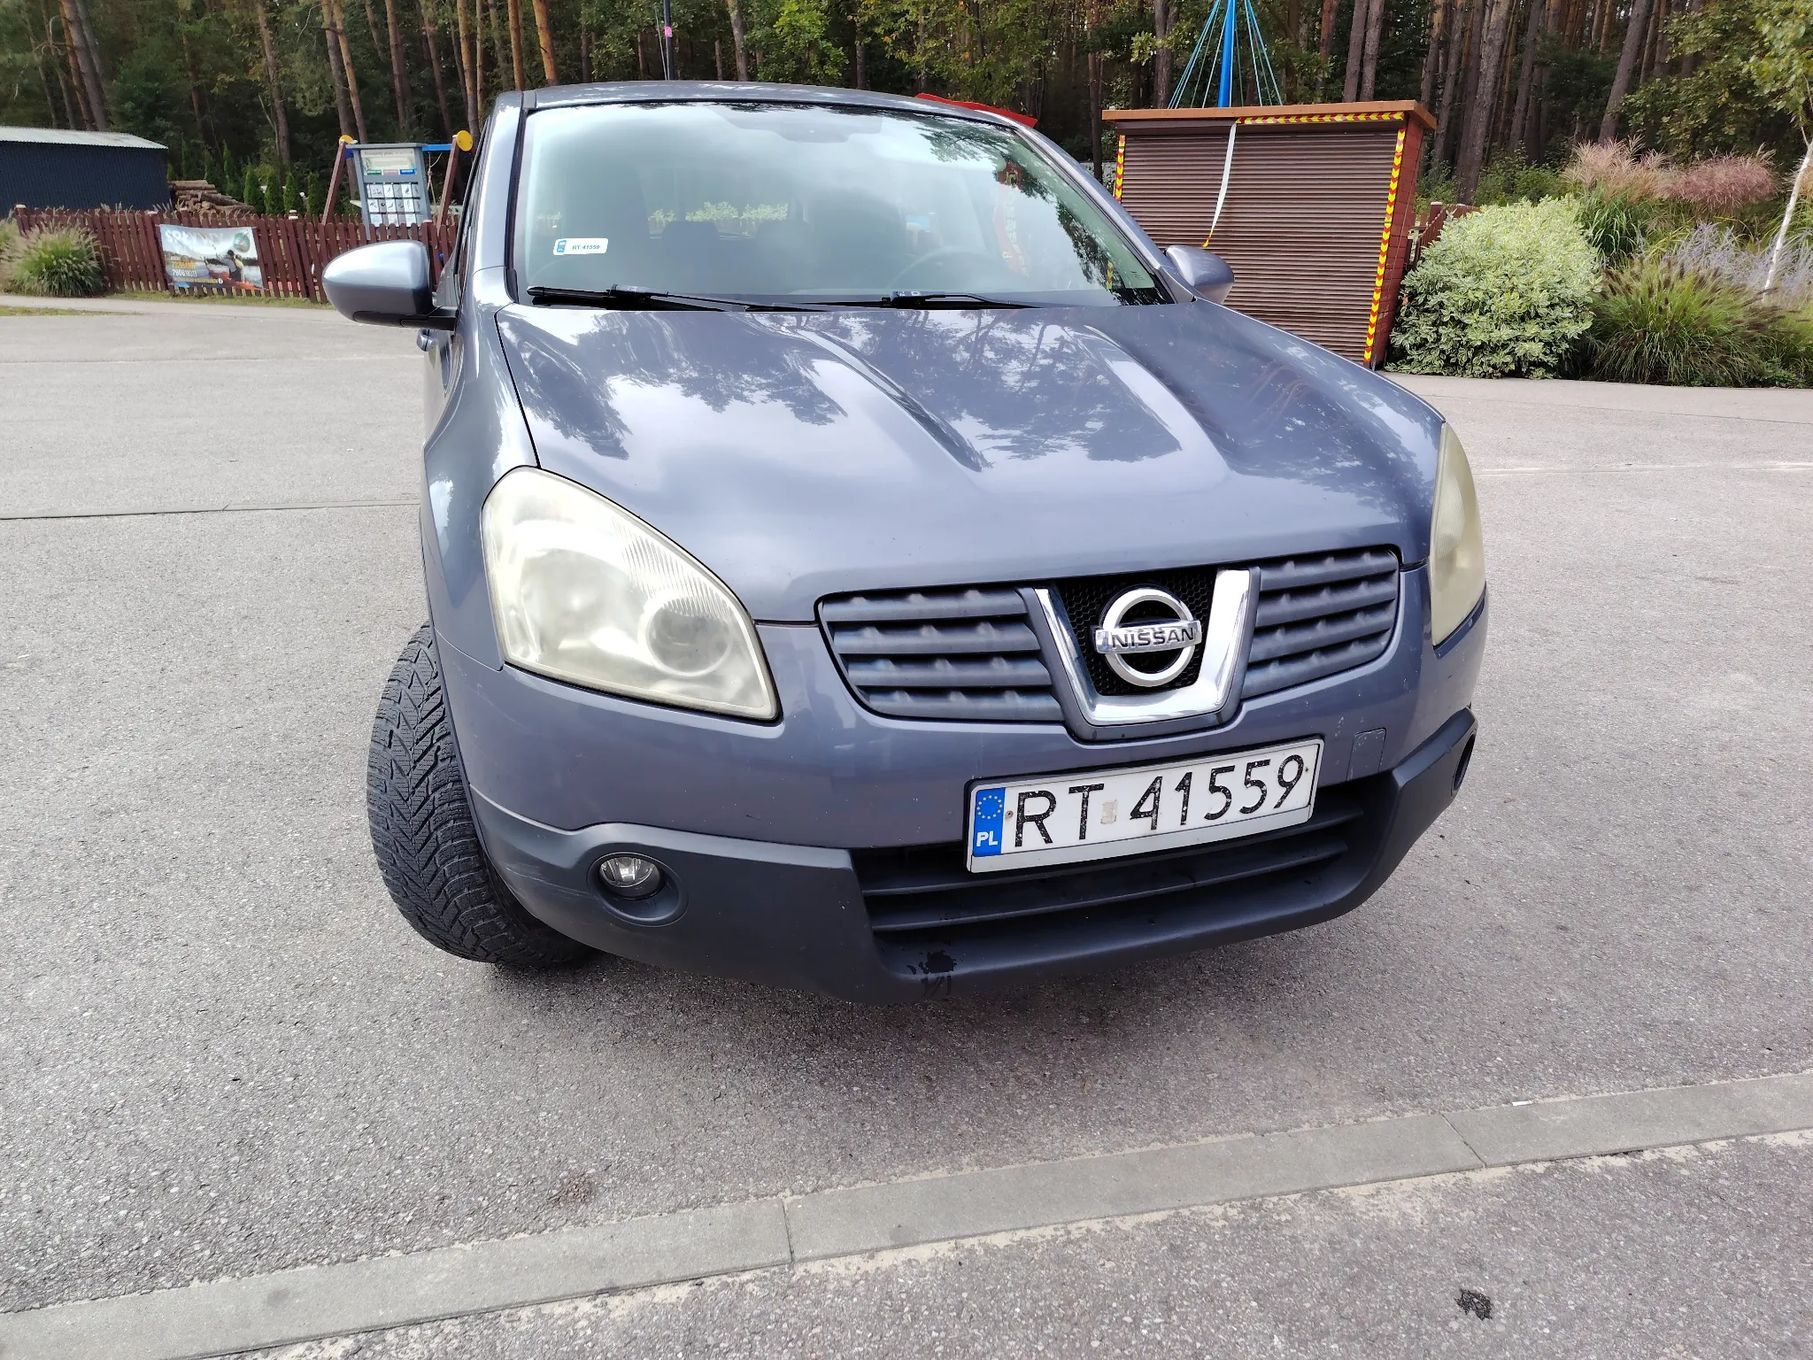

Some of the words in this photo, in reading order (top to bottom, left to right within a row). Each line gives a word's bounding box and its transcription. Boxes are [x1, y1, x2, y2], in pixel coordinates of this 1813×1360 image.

[1111, 627, 1194, 648] NISSAN
[1014, 783, 1104, 847] RT
[1130, 754, 1304, 831] 41559
[976, 831, 998, 847] PL
